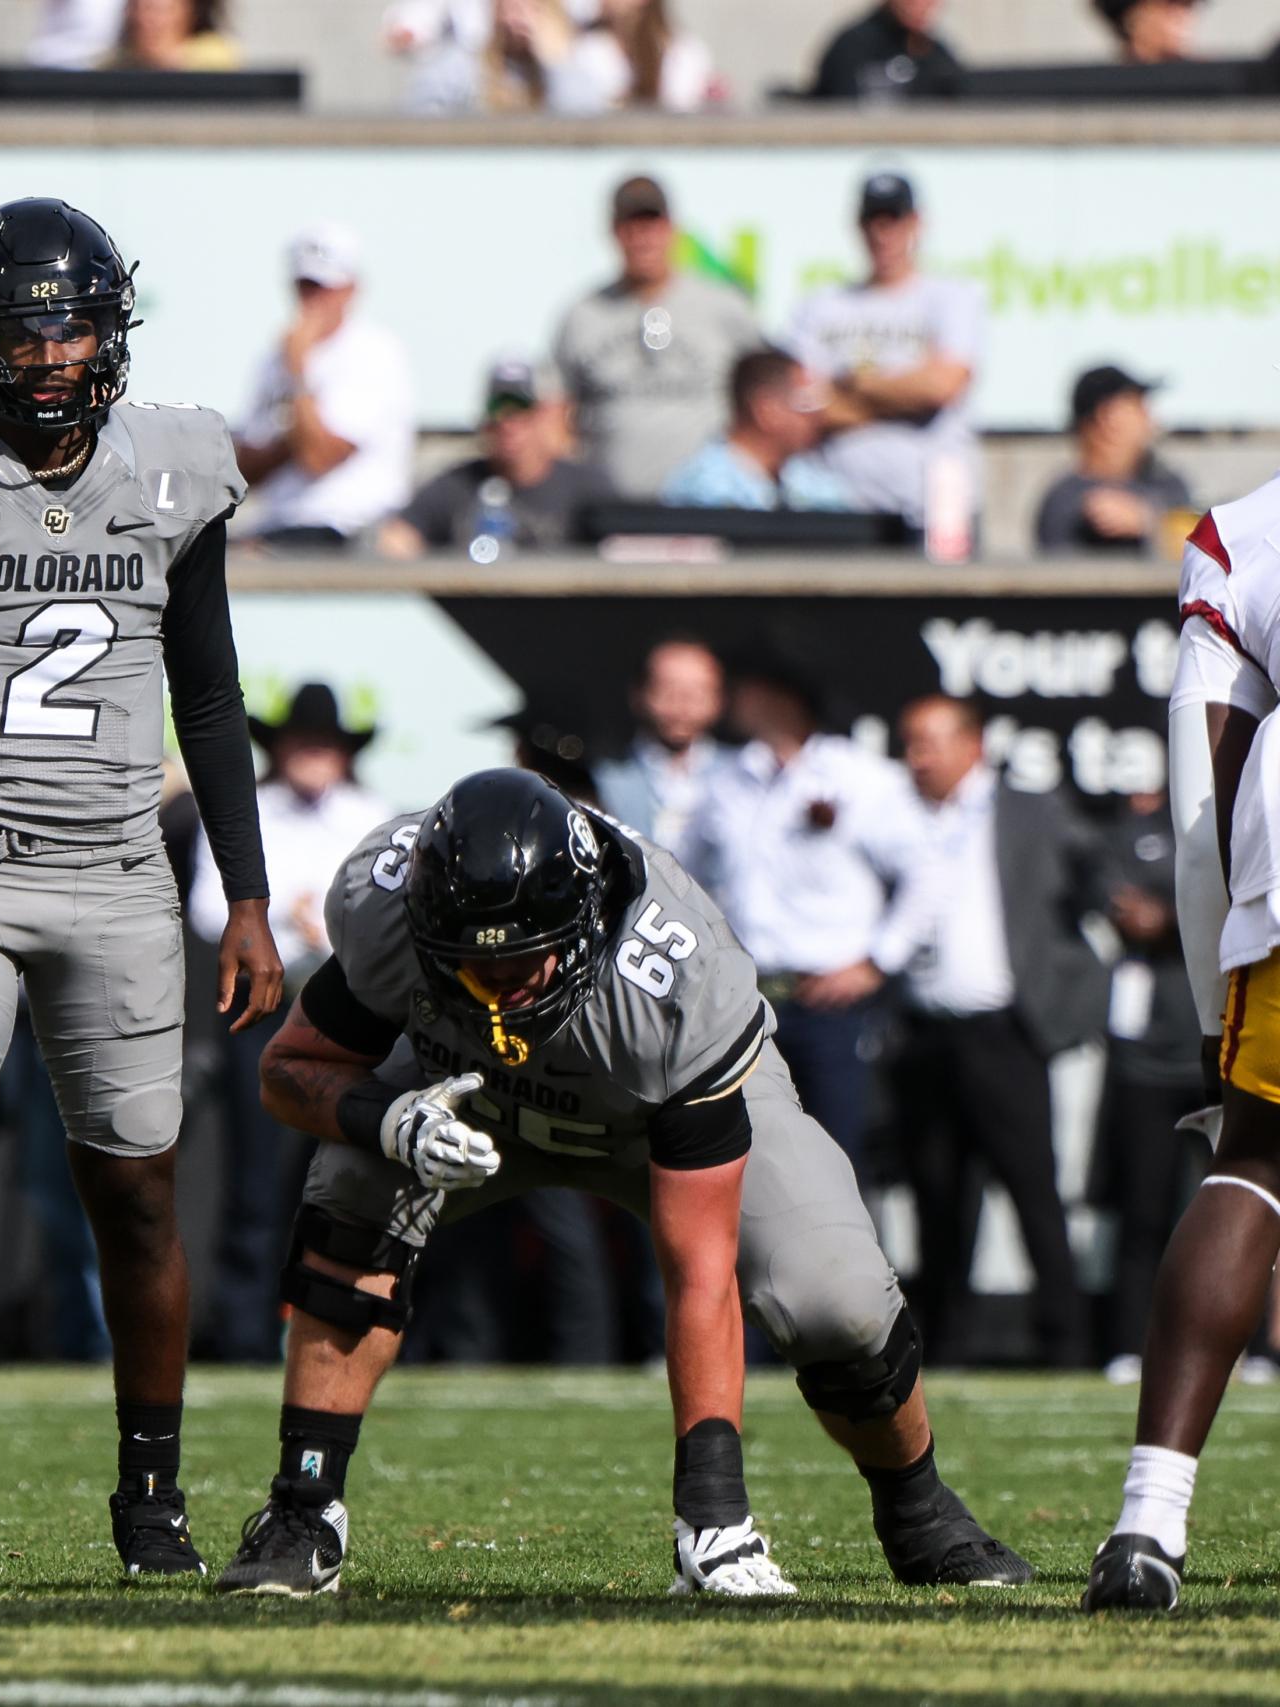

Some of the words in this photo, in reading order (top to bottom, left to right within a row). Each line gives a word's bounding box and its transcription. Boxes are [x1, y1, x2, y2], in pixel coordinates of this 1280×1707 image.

[156, 472, 176, 510] L
[922, 616, 1127, 698] Your
[615, 900, 699, 999] 65
